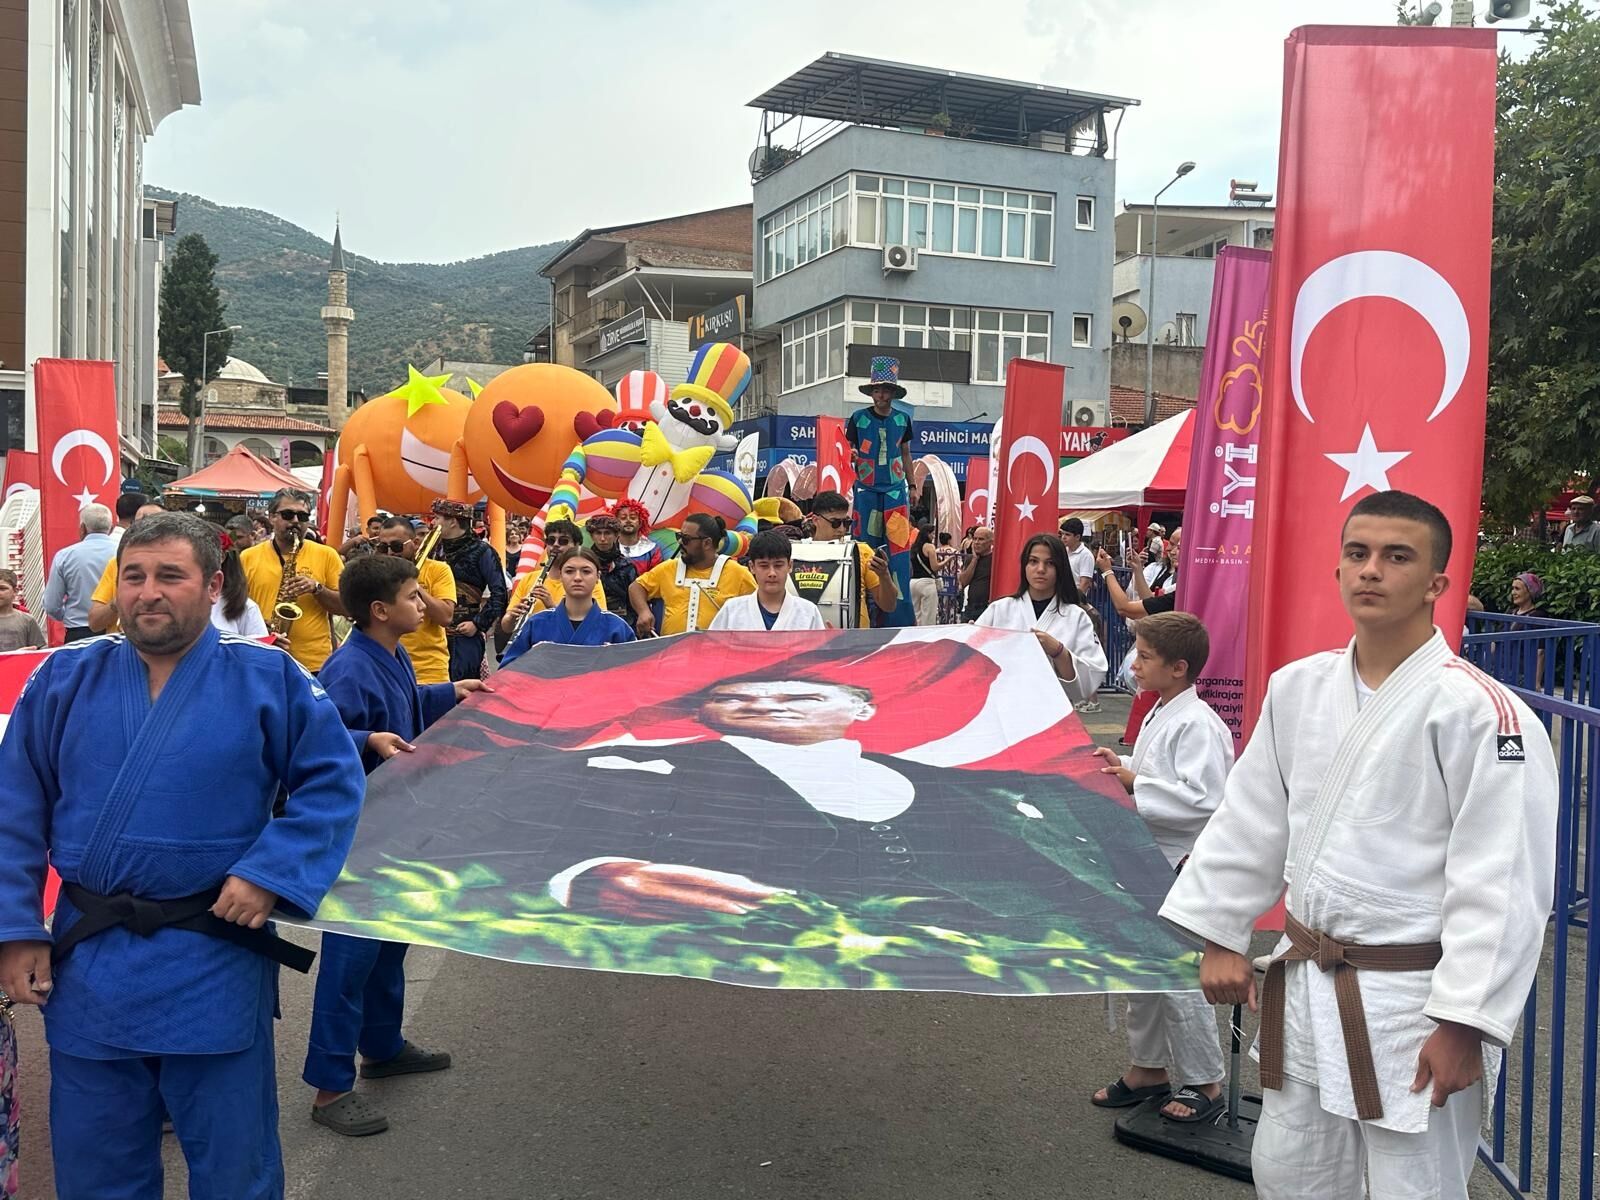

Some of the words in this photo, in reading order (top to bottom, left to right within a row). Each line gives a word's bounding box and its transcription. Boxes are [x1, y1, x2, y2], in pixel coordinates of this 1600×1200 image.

[1232, 320, 1267, 359] 25
[790, 426, 816, 441] ŞAH
[920, 428, 969, 445] ŞAHİNCİ
[1210, 443, 1258, 519] İYİ
[1217, 544, 1252, 555] AJA
[1195, 677, 1244, 687] organizas
[1197, 690, 1243, 700] yifikirajan
